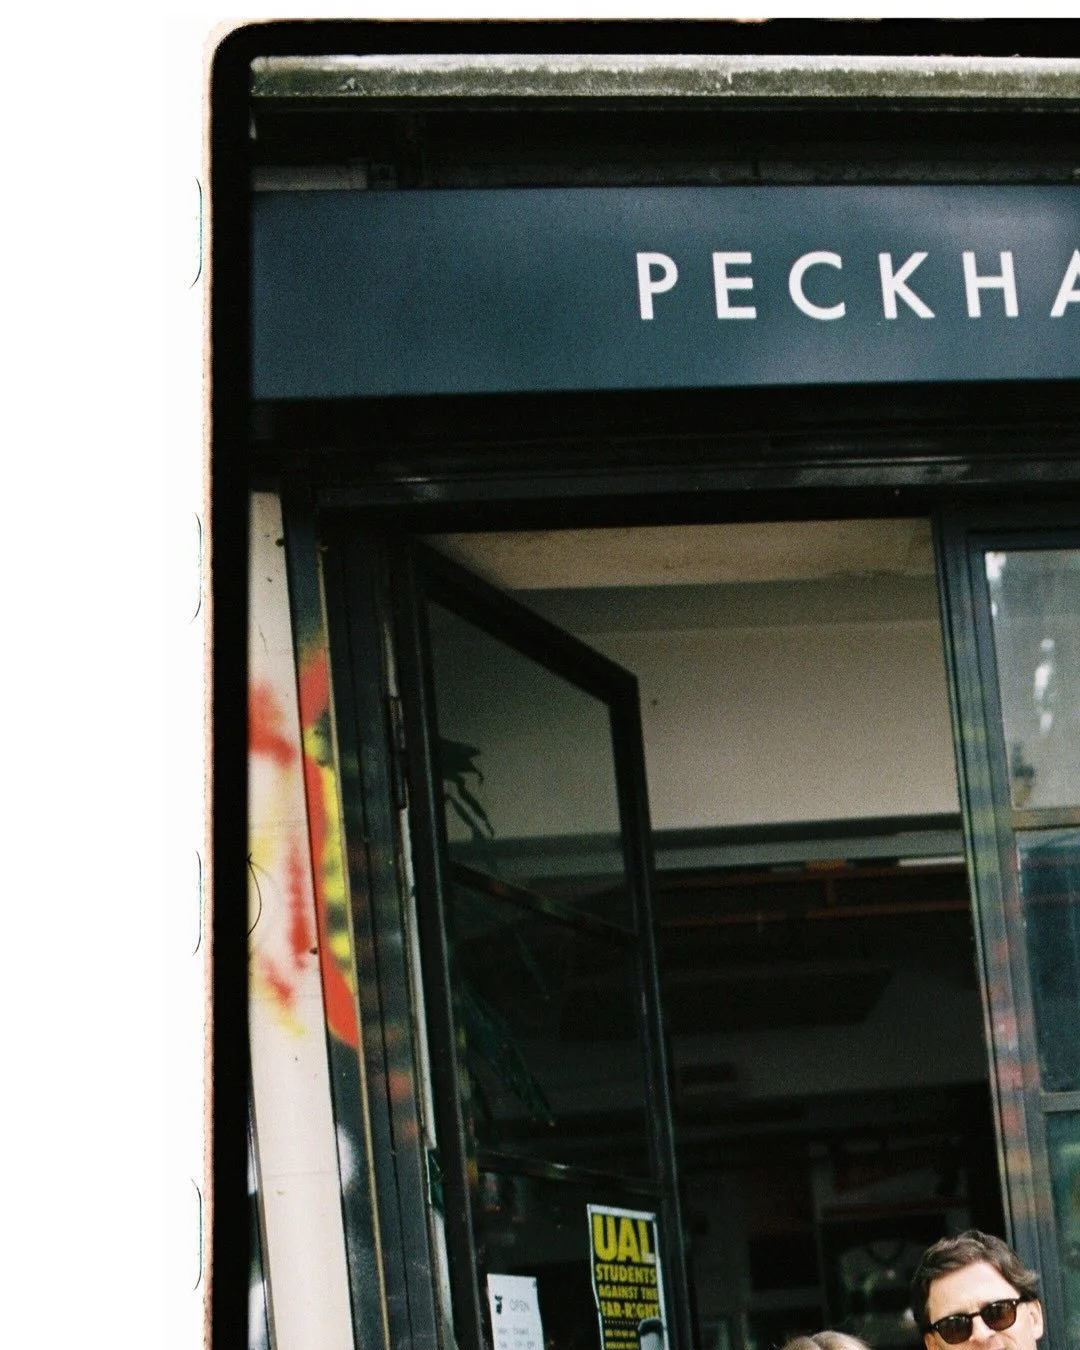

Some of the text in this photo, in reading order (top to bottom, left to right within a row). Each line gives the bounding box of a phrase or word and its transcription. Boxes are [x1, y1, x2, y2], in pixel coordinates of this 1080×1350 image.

[593, 1214, 656, 1263] UAL
[595, 1263, 657, 1284] STUDENTS
[598, 1284, 639, 1299] AGAINST
[600, 1301, 660, 1319] FAR-RIGHT
